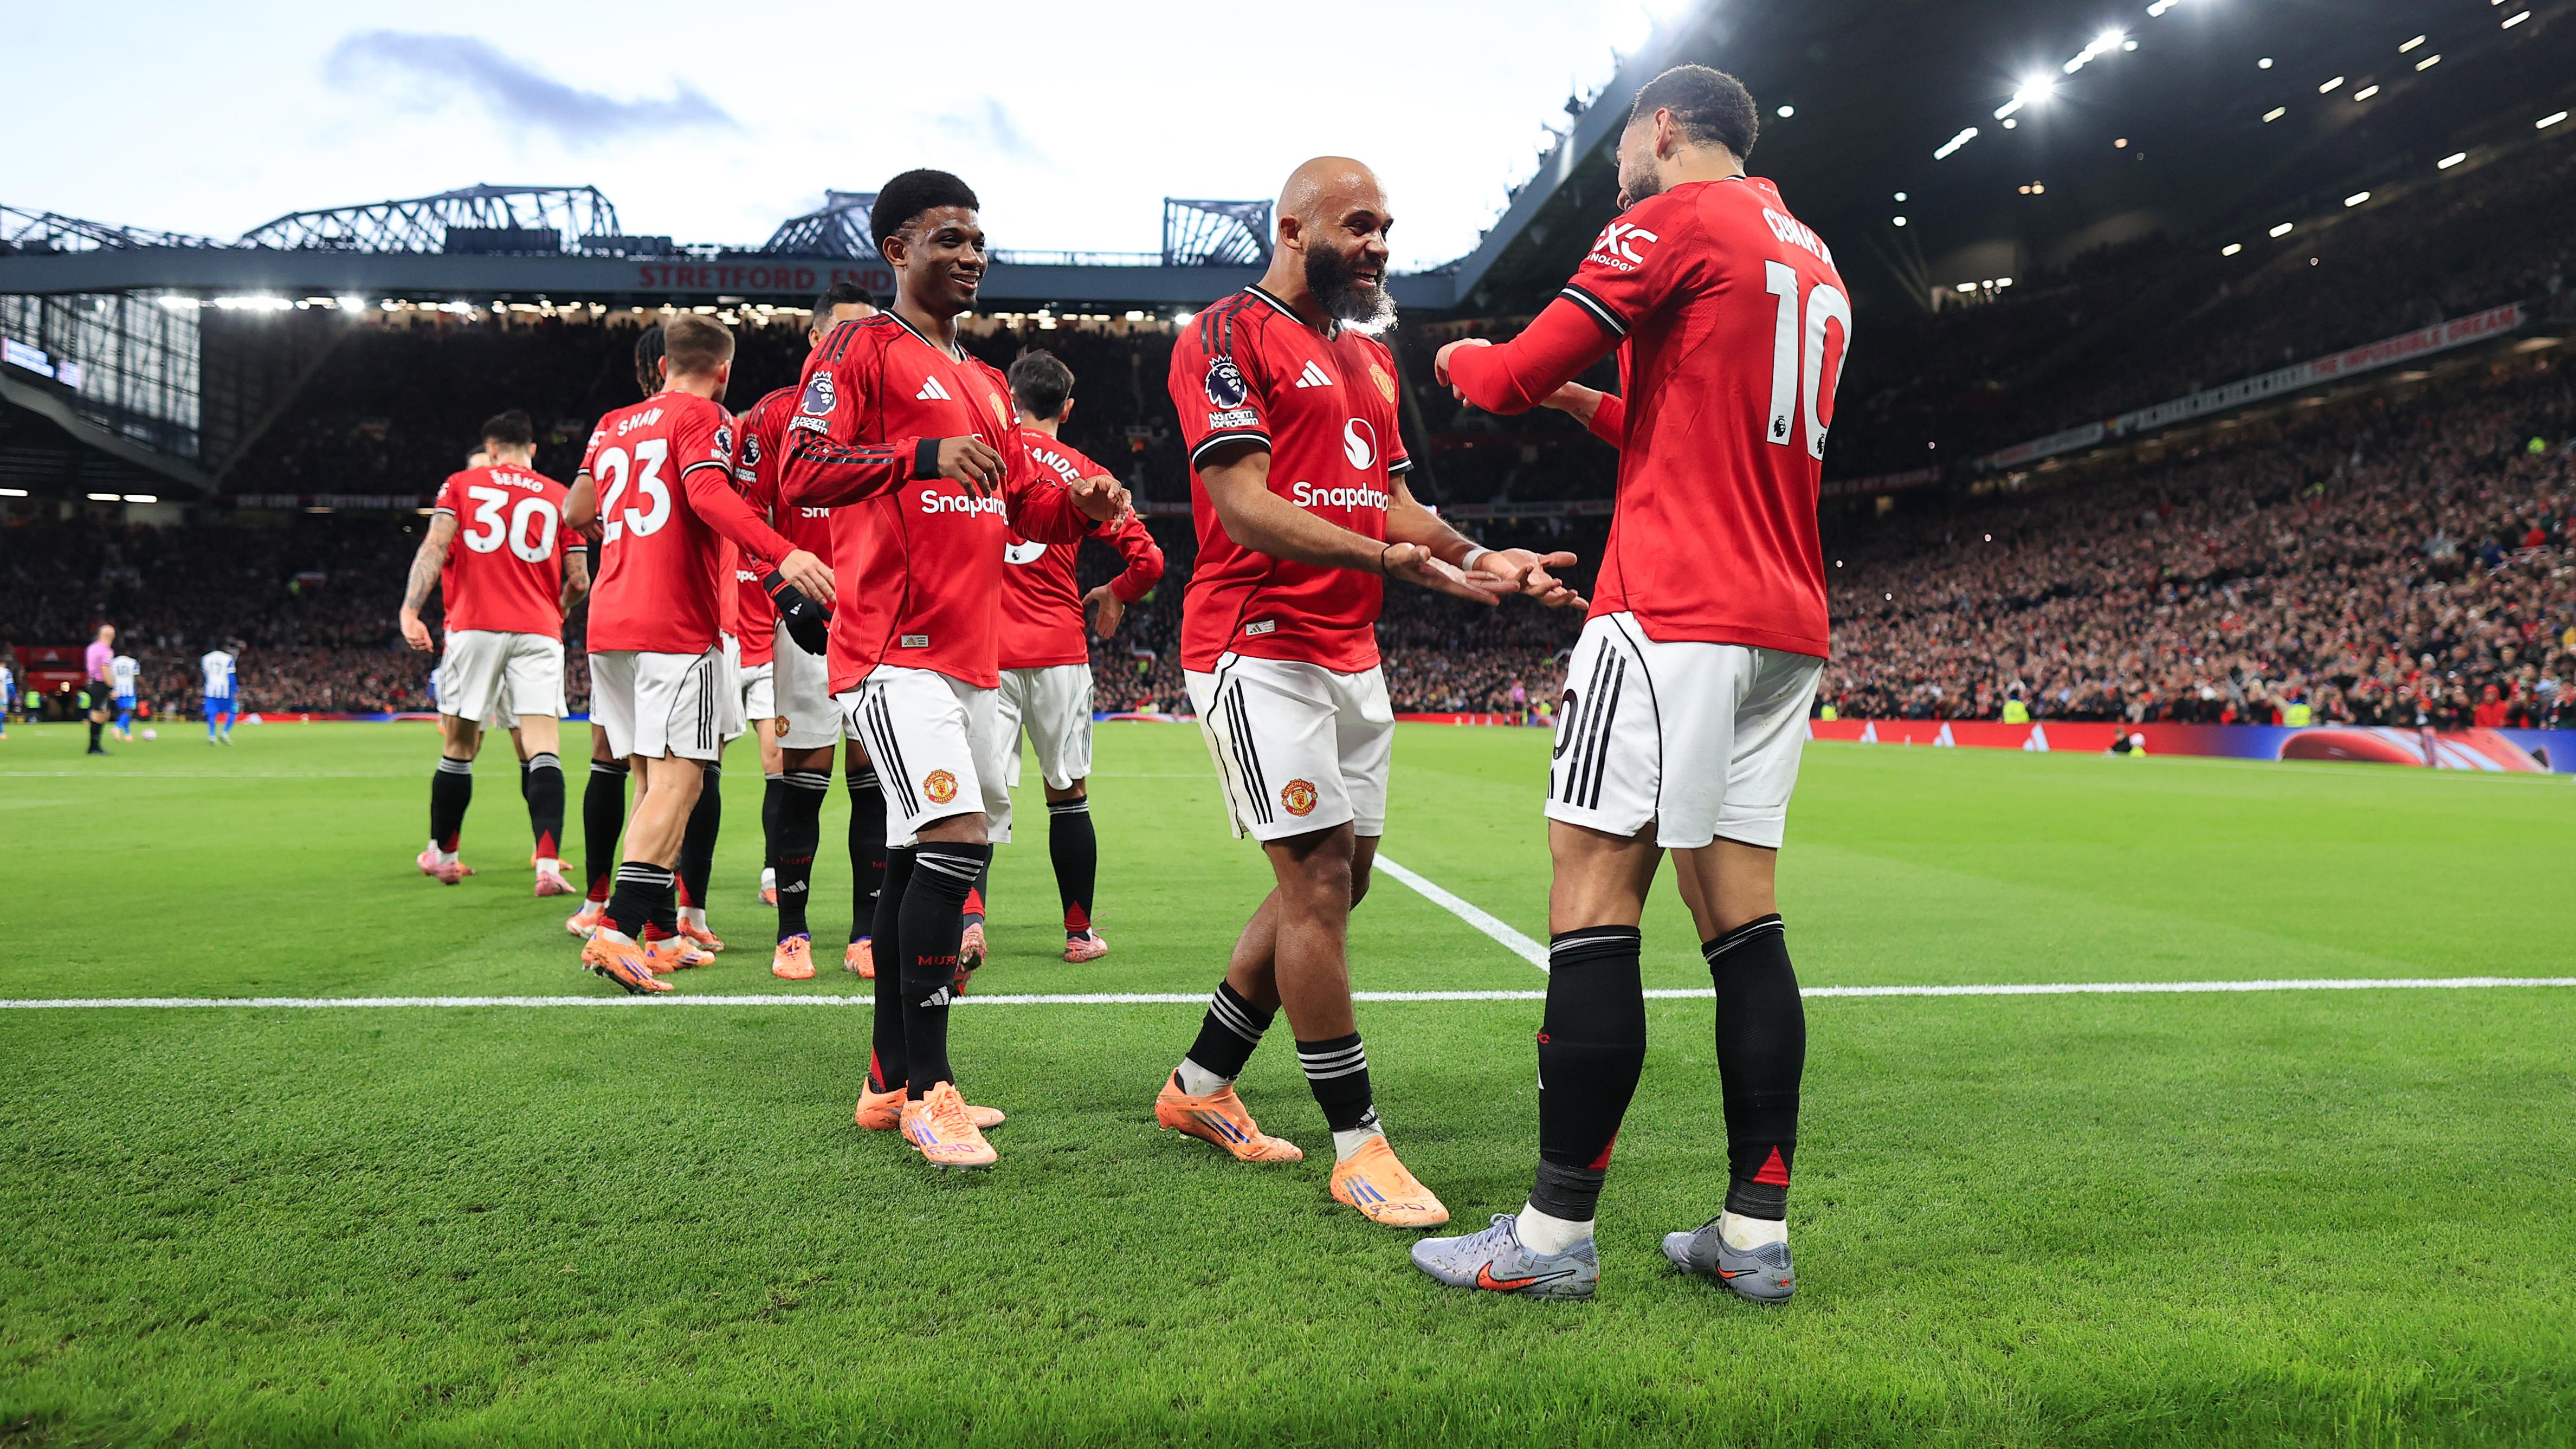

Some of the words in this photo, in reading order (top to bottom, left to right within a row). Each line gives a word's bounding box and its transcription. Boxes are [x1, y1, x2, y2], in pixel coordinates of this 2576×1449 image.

[1762, 208, 1836, 275] CUNHA
[1586, 253, 1636, 271] NOLOGY
[640, 265, 815, 289] STRETFORD
[1765, 259, 1852, 461] 10
[617, 407, 664, 437] SHAW
[1225, 410, 1253, 420] room
[1226, 418, 1259, 428] racism
[596, 438, 672, 544] 23
[463, 485, 559, 564] 30
[1283, 781, 1312, 797] MANCHESTER
[1292, 805, 1313, 814] UNITED
[918, 955, 957, 966] MUFC
